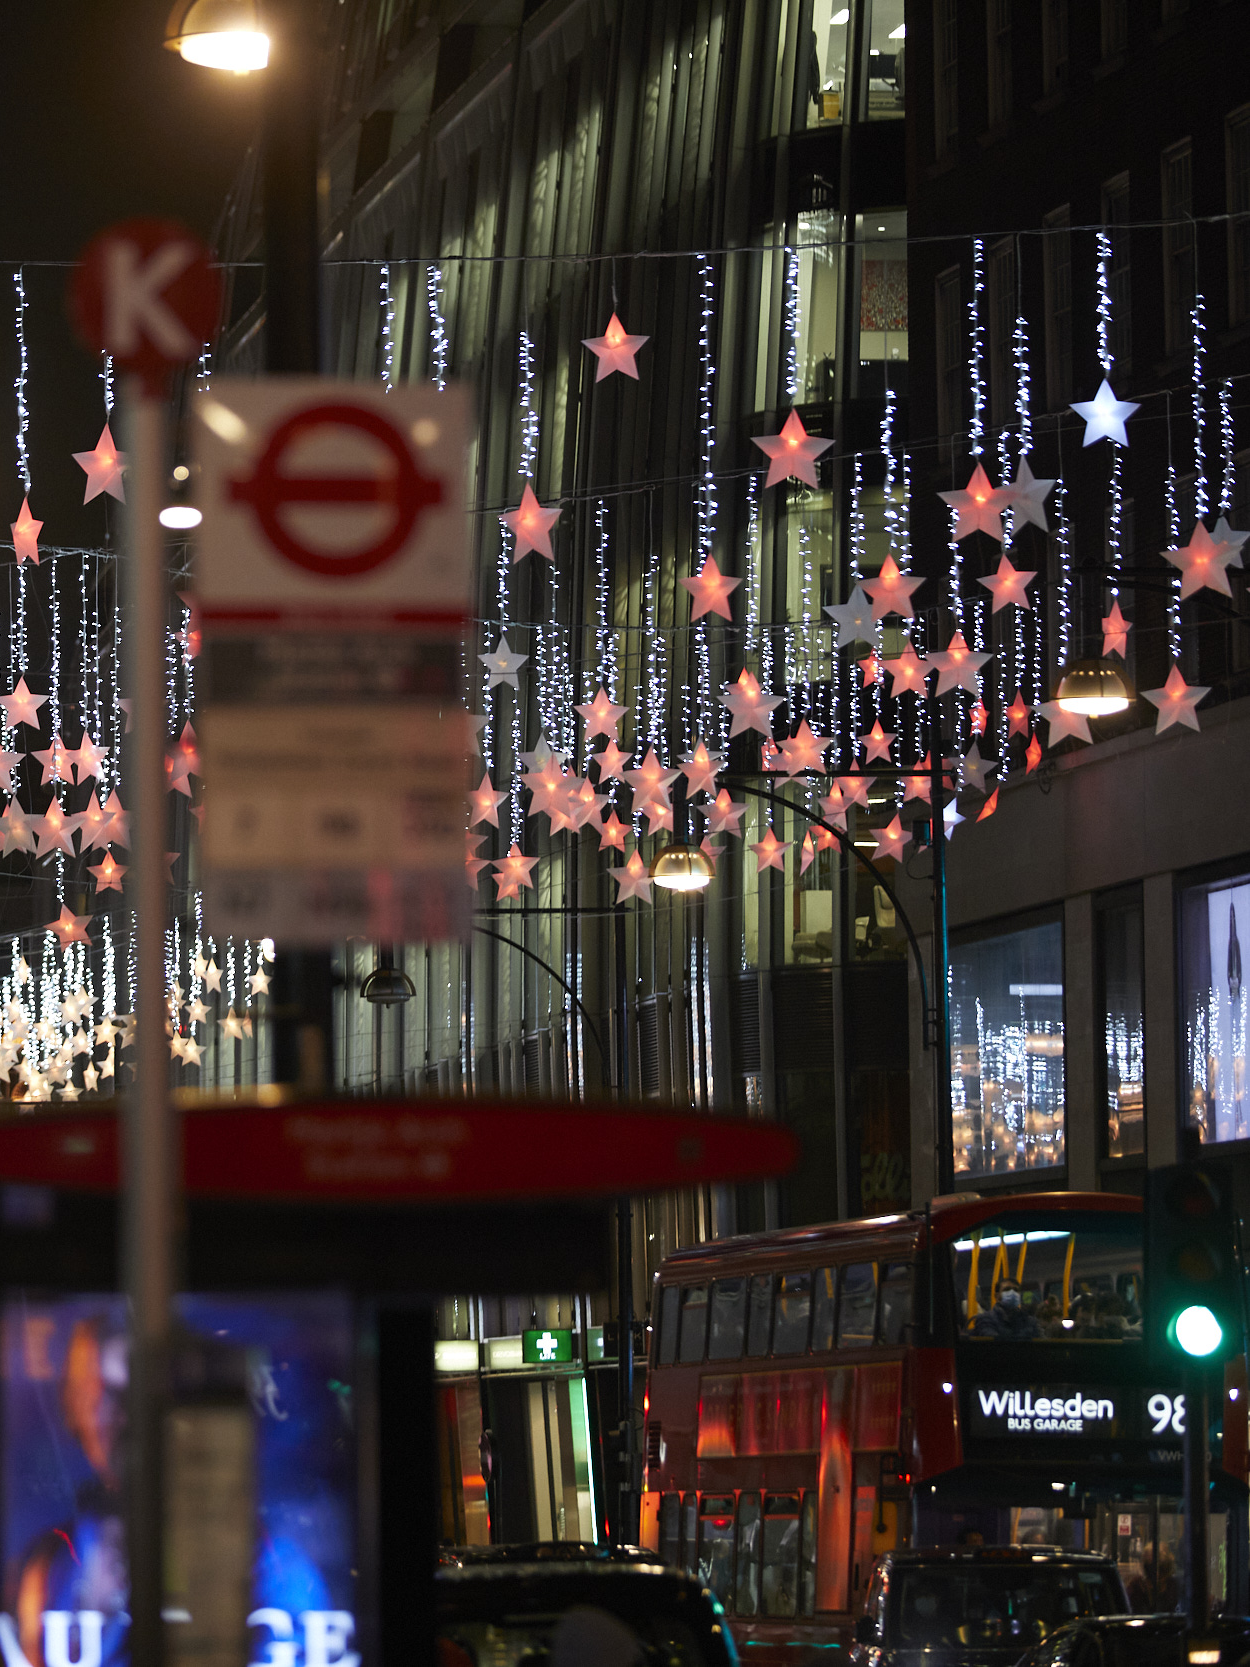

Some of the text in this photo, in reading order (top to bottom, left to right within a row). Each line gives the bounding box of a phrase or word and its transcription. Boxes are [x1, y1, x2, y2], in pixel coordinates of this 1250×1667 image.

[98, 238, 199, 359] K
[978, 1389, 1114, 1420] Willesden
[1007, 1417, 1083, 1432] BUS GARAGE
